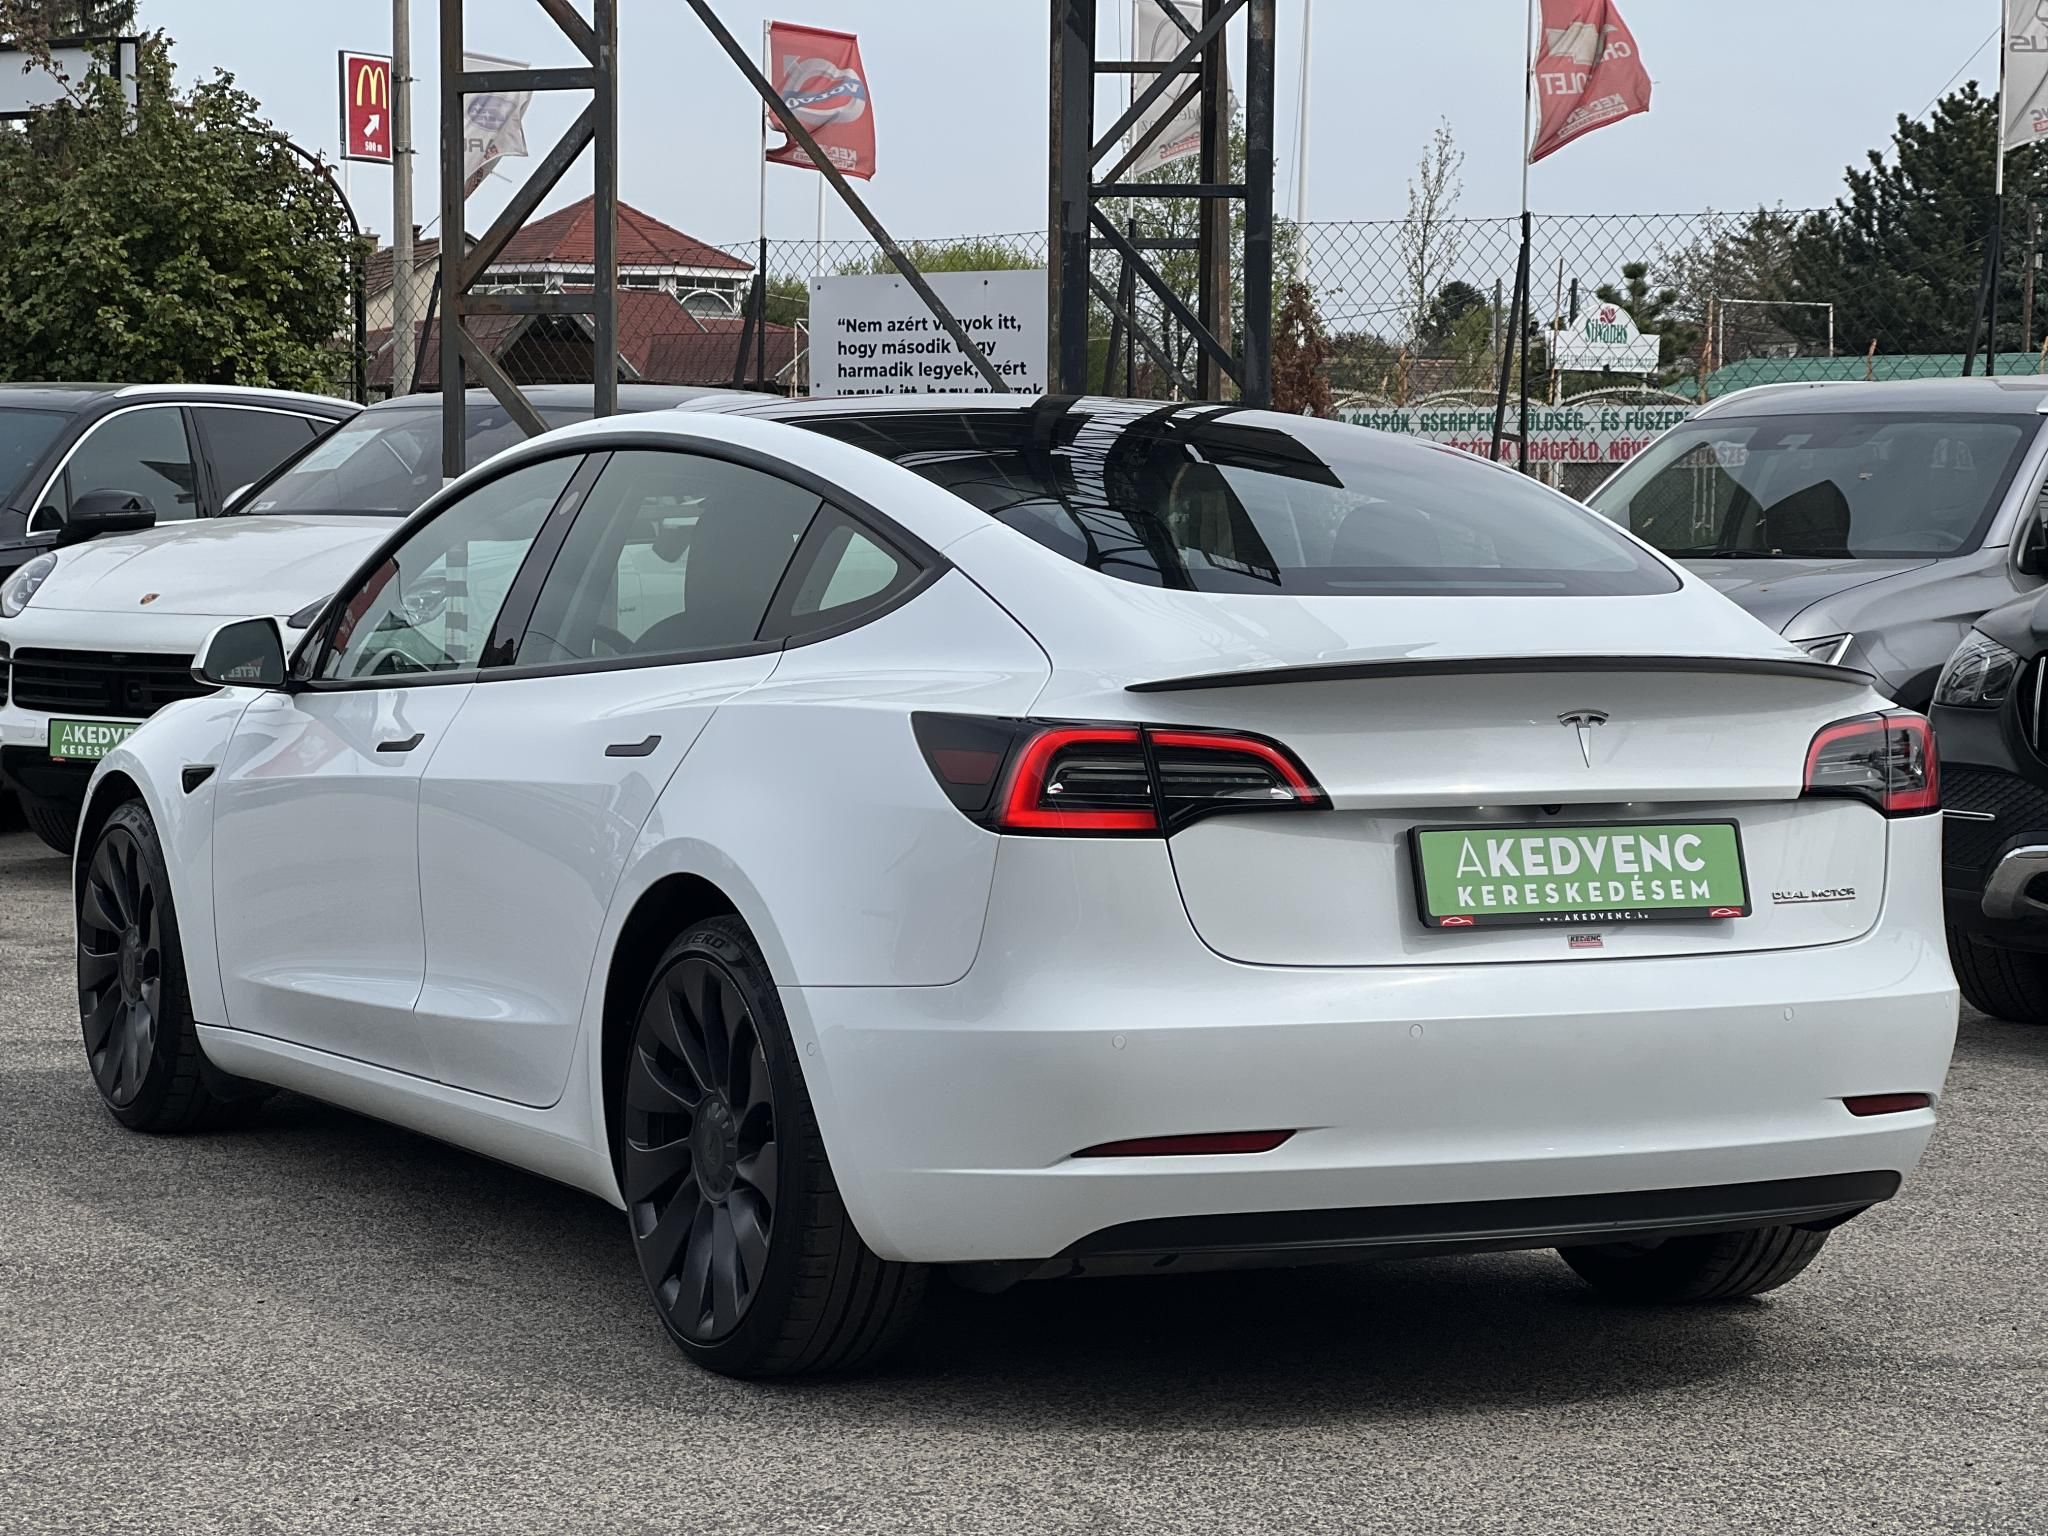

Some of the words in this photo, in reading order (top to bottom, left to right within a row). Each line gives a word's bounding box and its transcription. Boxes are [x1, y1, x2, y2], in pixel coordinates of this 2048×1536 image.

[364, 141, 377, 152] 500
[887, 316, 928, 332] azért
[932, 315, 993, 333] vyok
[998, 313, 1022, 332] itt,
[1585, 318, 1628, 344] Silvanus
[837, 340, 878, 358] hogy
[882, 337, 951, 354] második
[837, 361, 914, 378] harmadik
[918, 360, 979, 379] legyek,
[993, 360, 1027, 376] zért
[1601, 408, 1620, 431] ÉS
[61, 724, 135, 745] AKEDVE
[60, 744, 109, 756] KERESK
[1457, 874, 1711, 907] KERESKEDÉSEM
[1772, 890, 1809, 900] DUAL
[1811, 887, 1856, 898] MOTOR
